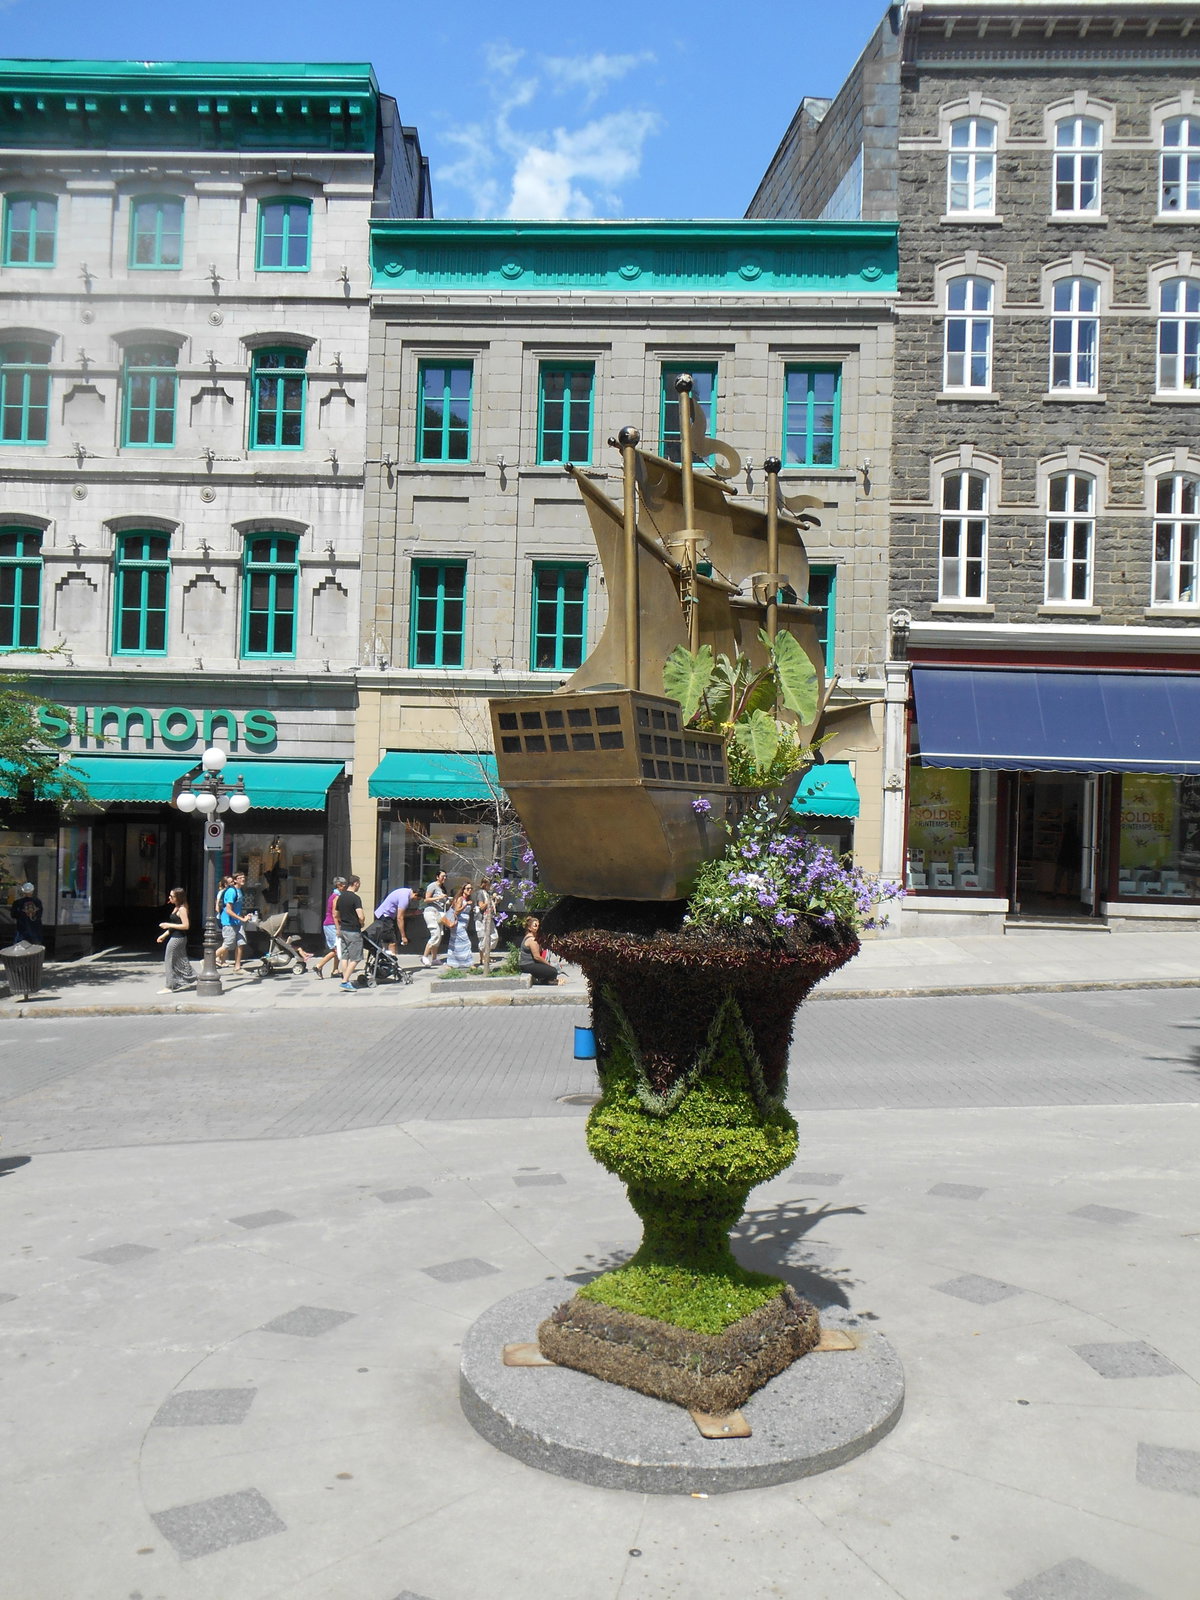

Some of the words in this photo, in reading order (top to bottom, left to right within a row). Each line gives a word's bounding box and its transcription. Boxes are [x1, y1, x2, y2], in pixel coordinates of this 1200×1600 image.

[36, 704, 277, 745] simons
[915, 808, 962, 822] SOLDES
[1120, 811, 1166, 824] SOLDES
